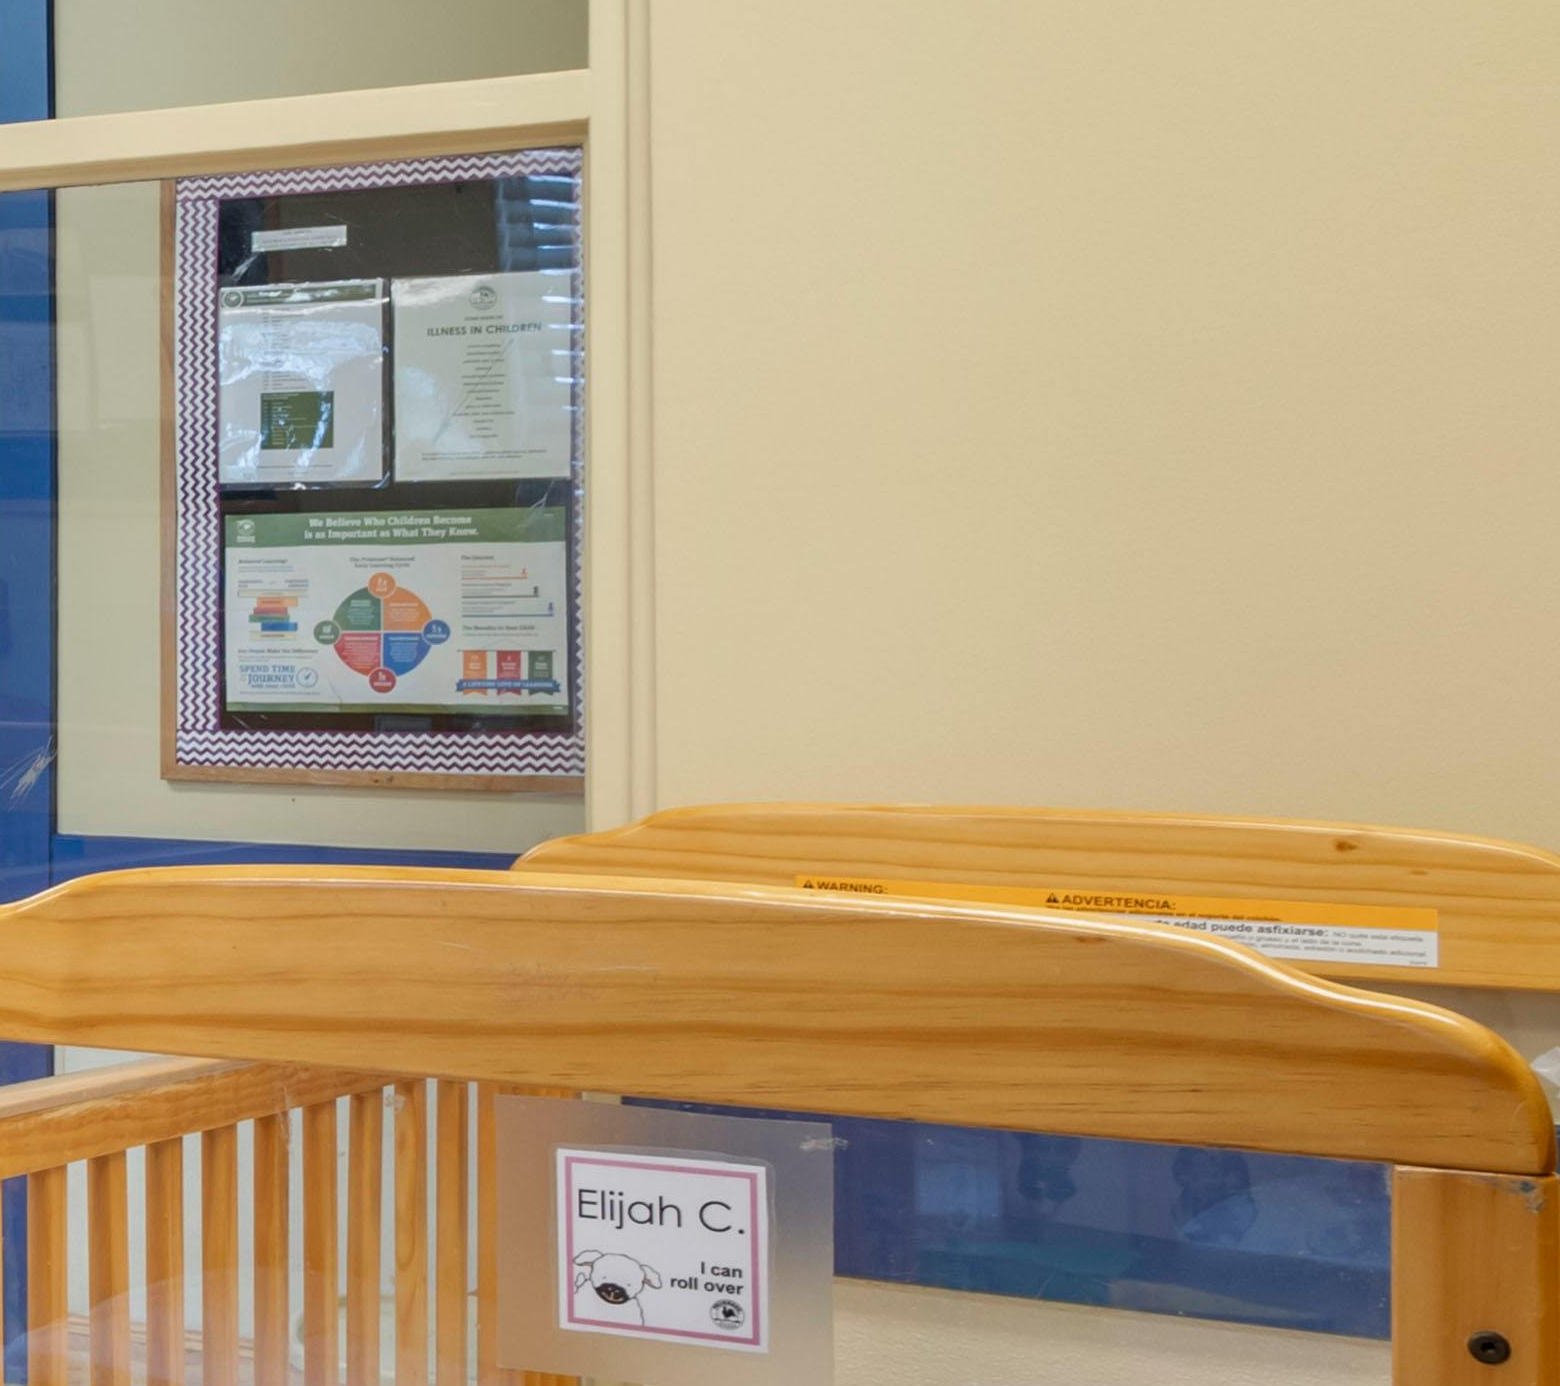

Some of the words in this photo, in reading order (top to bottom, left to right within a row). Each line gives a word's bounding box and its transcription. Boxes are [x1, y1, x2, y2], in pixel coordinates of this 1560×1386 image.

[427, 325, 467, 337] ILLNESS
[470, 325, 482, 334] IN
[486, 321, 542, 334] CHILDREN
[309, 517, 324, 527] We
[326, 516, 362, 527] Believe
[363, 516, 386, 526] Who
[387, 515, 431, 525] Children
[432, 514, 473, 525] Become
[314, 530, 326, 540] as
[328, 529, 377, 541] Important
[379, 529, 390, 538] as
[392, 527, 419, 538] What
[421, 527, 447, 539] They
[239, 664, 270, 673] SPEND
[271, 664, 296, 673] TIME
[247, 673, 295, 686] JOURNEY
[816, 880, 889, 895] WARNING:
[1062, 894, 1176, 910] ADVERTENCIA:
[1174, 919, 1207, 931] edad
[1210, 922, 1253, 935] puede
[1256, 923, 1329, 937] asfixiarse:
[578, 1188, 682, 1230] Elijah
[698, 1200, 745, 1235] C.
[700, 1261, 705, 1275] I
[711, 1265, 743, 1279] can
[670, 1276, 699, 1291] roll
[704, 1280, 744, 1296] over
